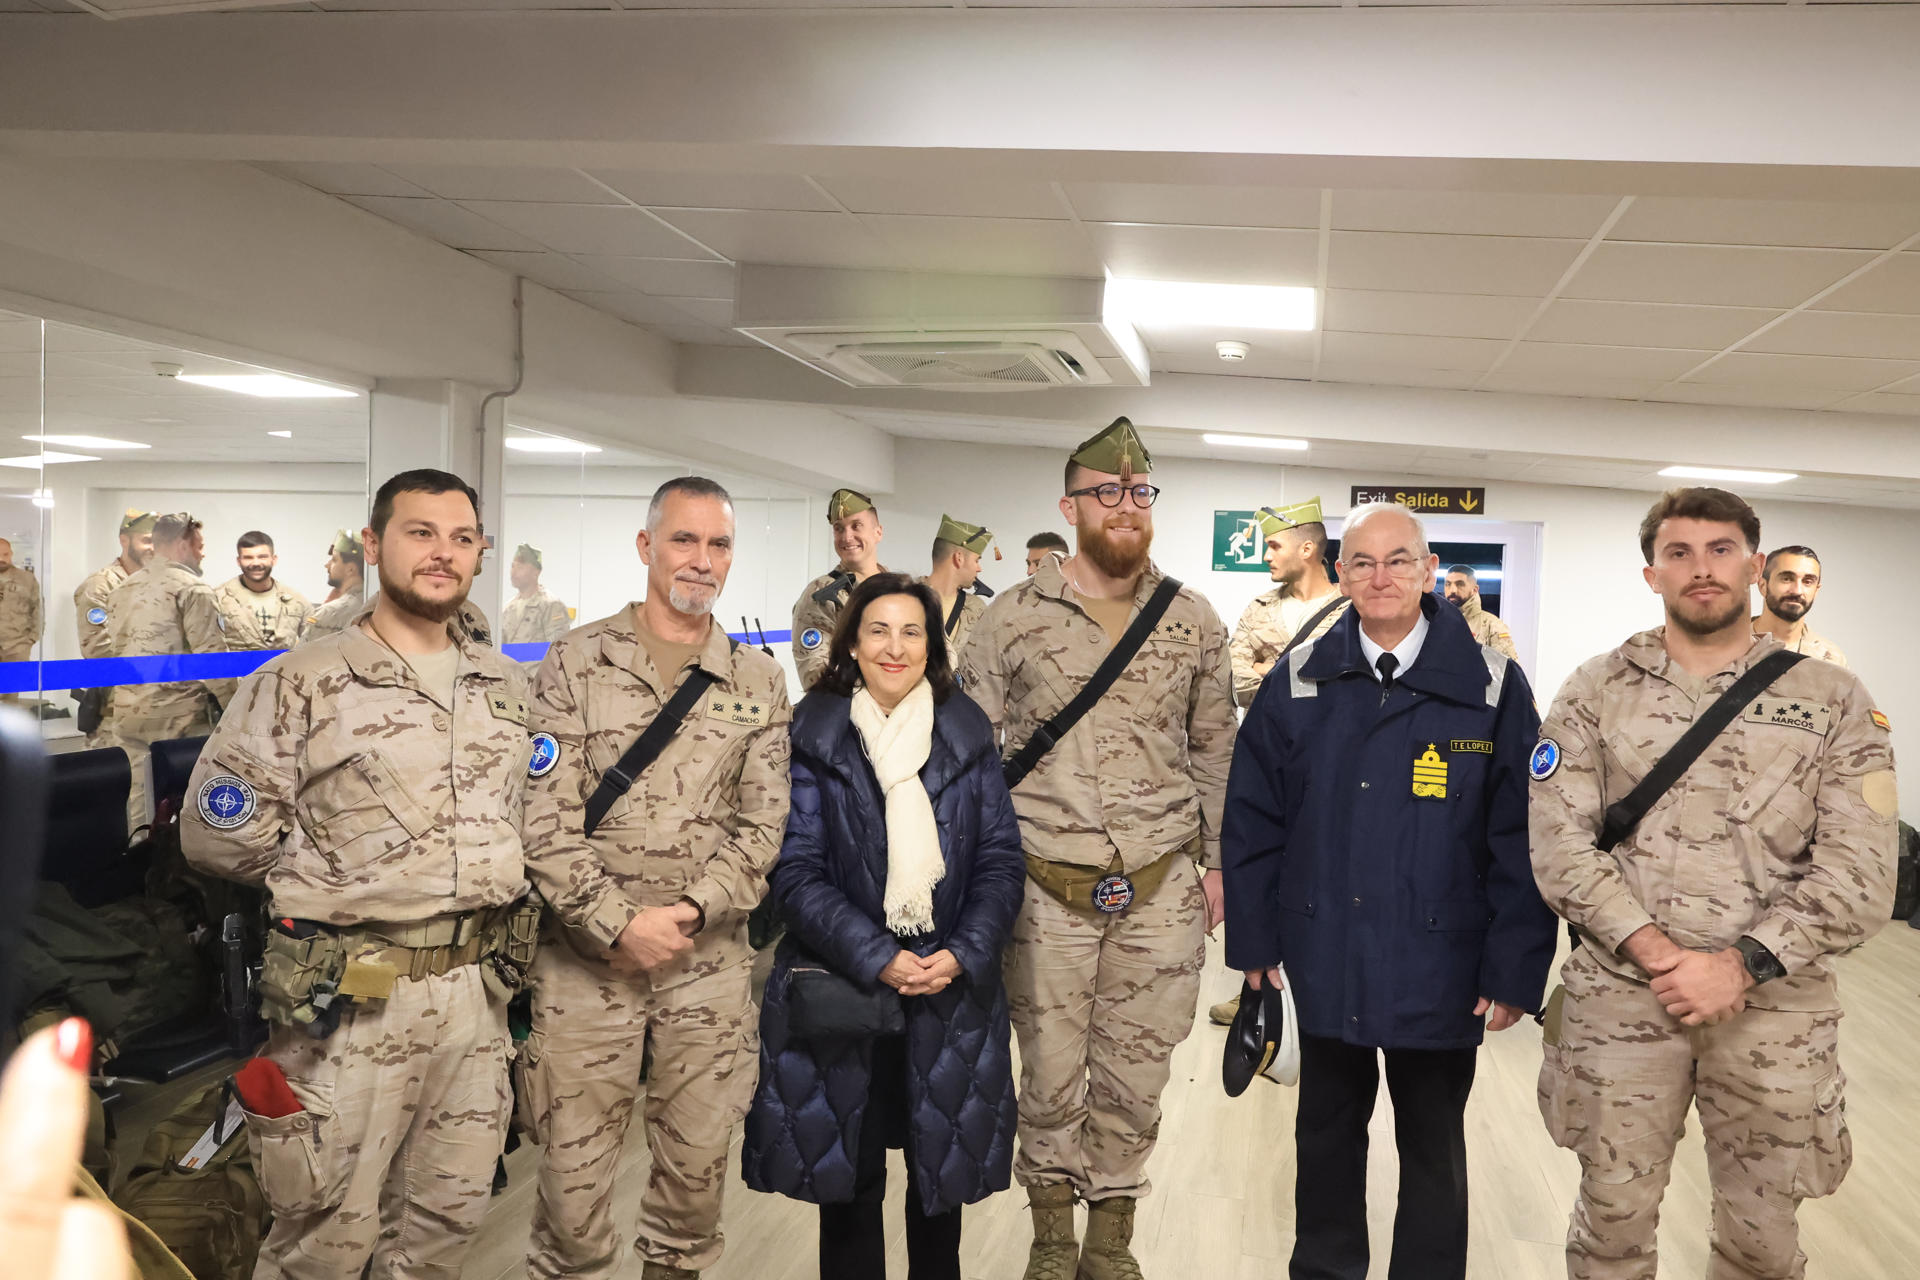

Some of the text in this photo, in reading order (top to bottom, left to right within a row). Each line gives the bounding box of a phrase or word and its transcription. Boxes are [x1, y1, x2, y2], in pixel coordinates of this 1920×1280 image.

[1357, 491, 1449, 507] Exit Salida
[732, 715, 759, 723] CAMACHO
[1771, 716, 1814, 729] MARCOS
[1466, 742, 1489, 750] LOPEZ
[202, 783, 215, 797] NATO
